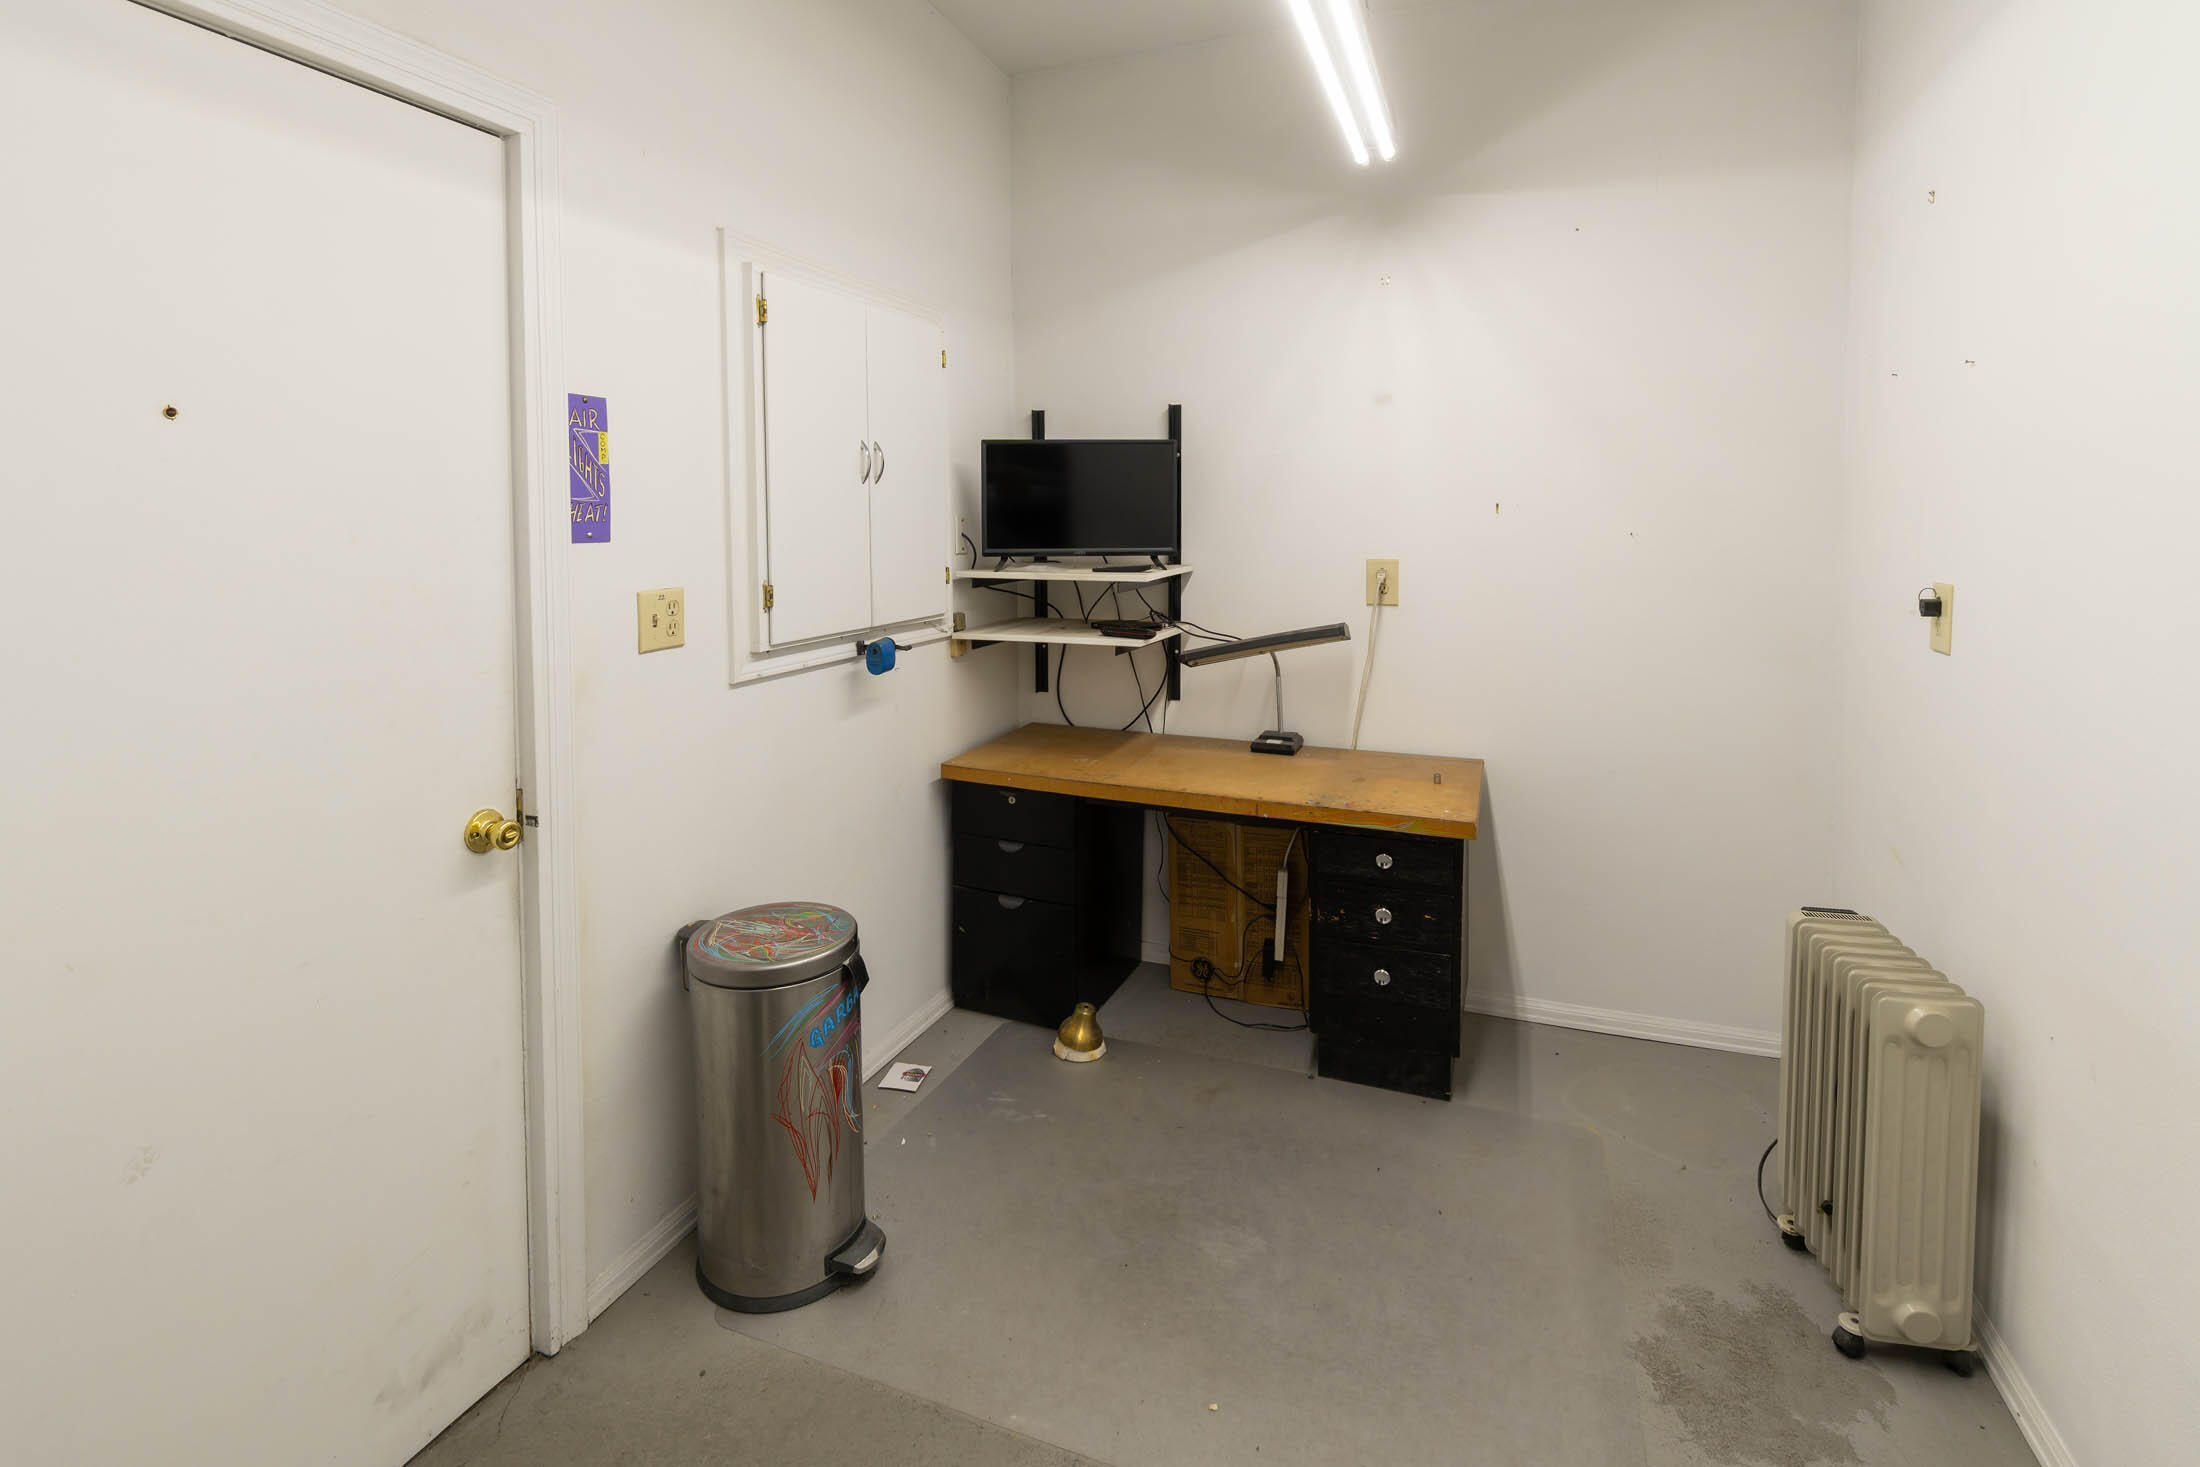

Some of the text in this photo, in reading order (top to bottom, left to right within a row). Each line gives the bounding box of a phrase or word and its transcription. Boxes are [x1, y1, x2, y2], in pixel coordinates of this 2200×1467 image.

[568, 407, 600, 430] AIR
[599, 433, 607, 462] COMP
[569, 436, 606, 497] IGHTS
[569, 502, 609, 523] HEAT!
